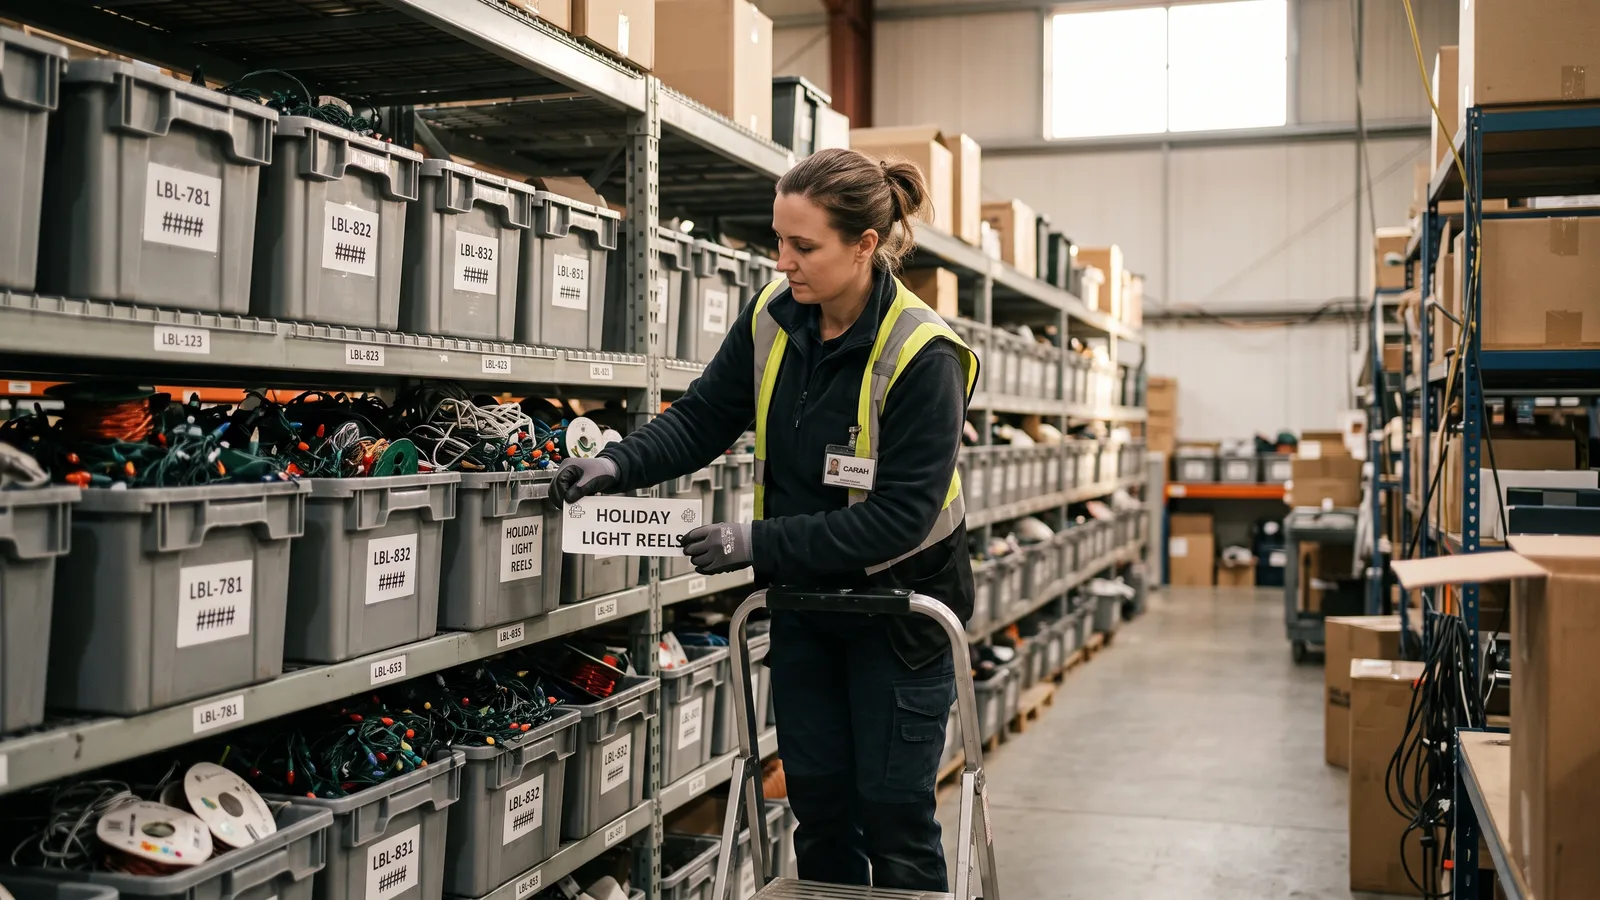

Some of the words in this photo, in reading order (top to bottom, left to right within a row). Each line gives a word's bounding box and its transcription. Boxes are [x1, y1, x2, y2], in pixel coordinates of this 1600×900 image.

[156, 180, 211, 207] LBL-781
[331, 215, 371, 239] LBL-822
[460, 243, 493, 261] LBL-832
[557, 264, 584, 281] LBL-851
[162, 332, 203, 348] LBL-123
[350, 349, 380, 362] LBL-823
[843, 466, 869, 475] CARAH
[596, 508, 671, 525] HOLIDAY
[506, 524, 539, 539] HOLIDAY
[582, 531, 631, 546] LIGHT
[636, 533, 684, 548] REELS
[373, 546, 411, 566] LBL-832
[511, 541, 533, 555] LIGHT
[511, 558, 533, 573] REELS
[190, 576, 243, 600] LBL-781
[374, 662, 402, 678] LBL-653
[200, 704, 238, 725] LBL-781
[509, 786, 540, 811] LBL-832
[373, 839, 413, 871] LBL-831
